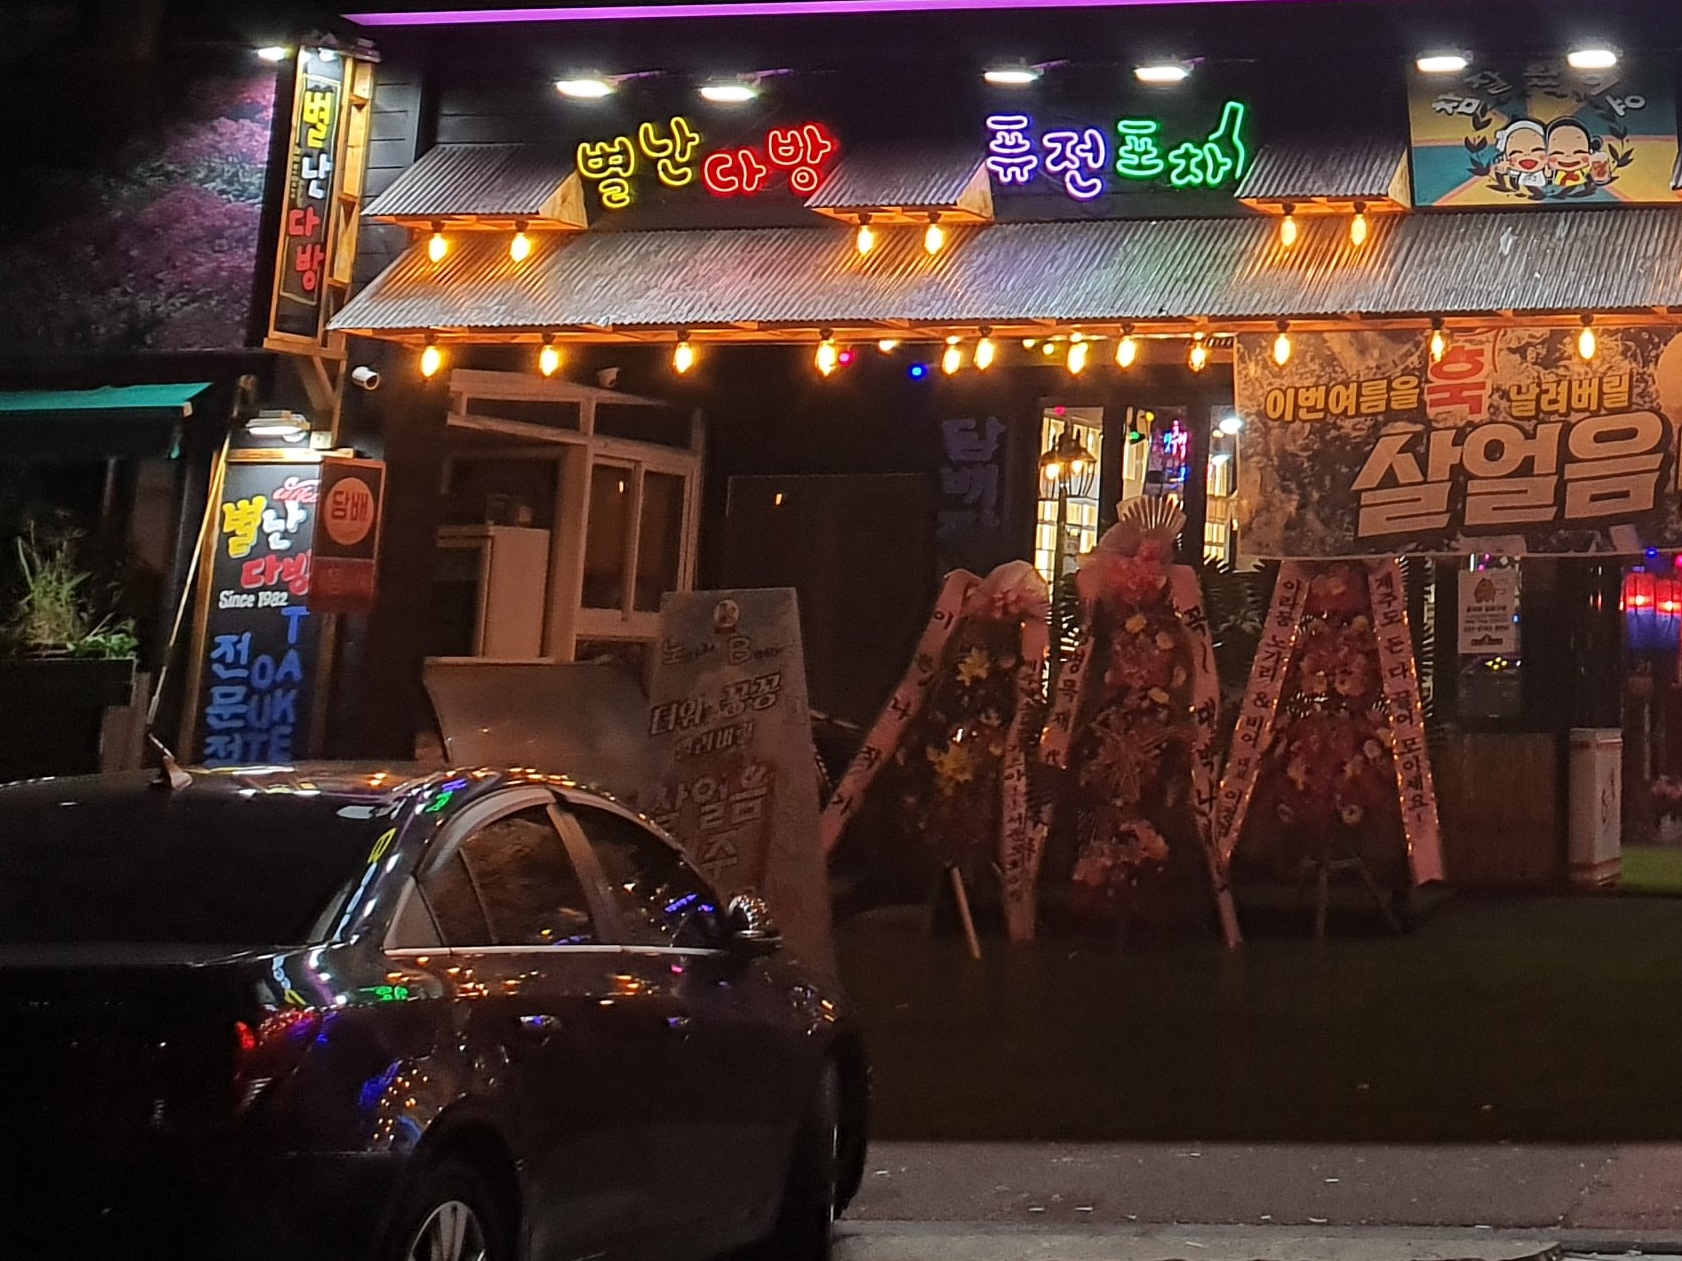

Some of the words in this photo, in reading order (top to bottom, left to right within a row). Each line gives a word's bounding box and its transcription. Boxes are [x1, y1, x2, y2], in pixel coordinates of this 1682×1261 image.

[301, 85, 334, 201] 별난
[576, 116, 701, 209] 별난
[703, 123, 833, 194] 다방
[985, 113, 1106, 198] 퓨전
[1115, 101, 1247, 187] 포차
[288, 205, 326, 292] 다방
[1507, 369, 1635, 420] 날려버릴
[331, 489, 370, 522] 담배
[1353, 409, 1672, 541] 살얼음
[222, 493, 308, 560] 별난
[218, 589, 256, 611] Since
[256, 589, 289, 608] 1982
[239, 548, 312, 597] 다방
[1373, 570, 1404, 627] 제주도
